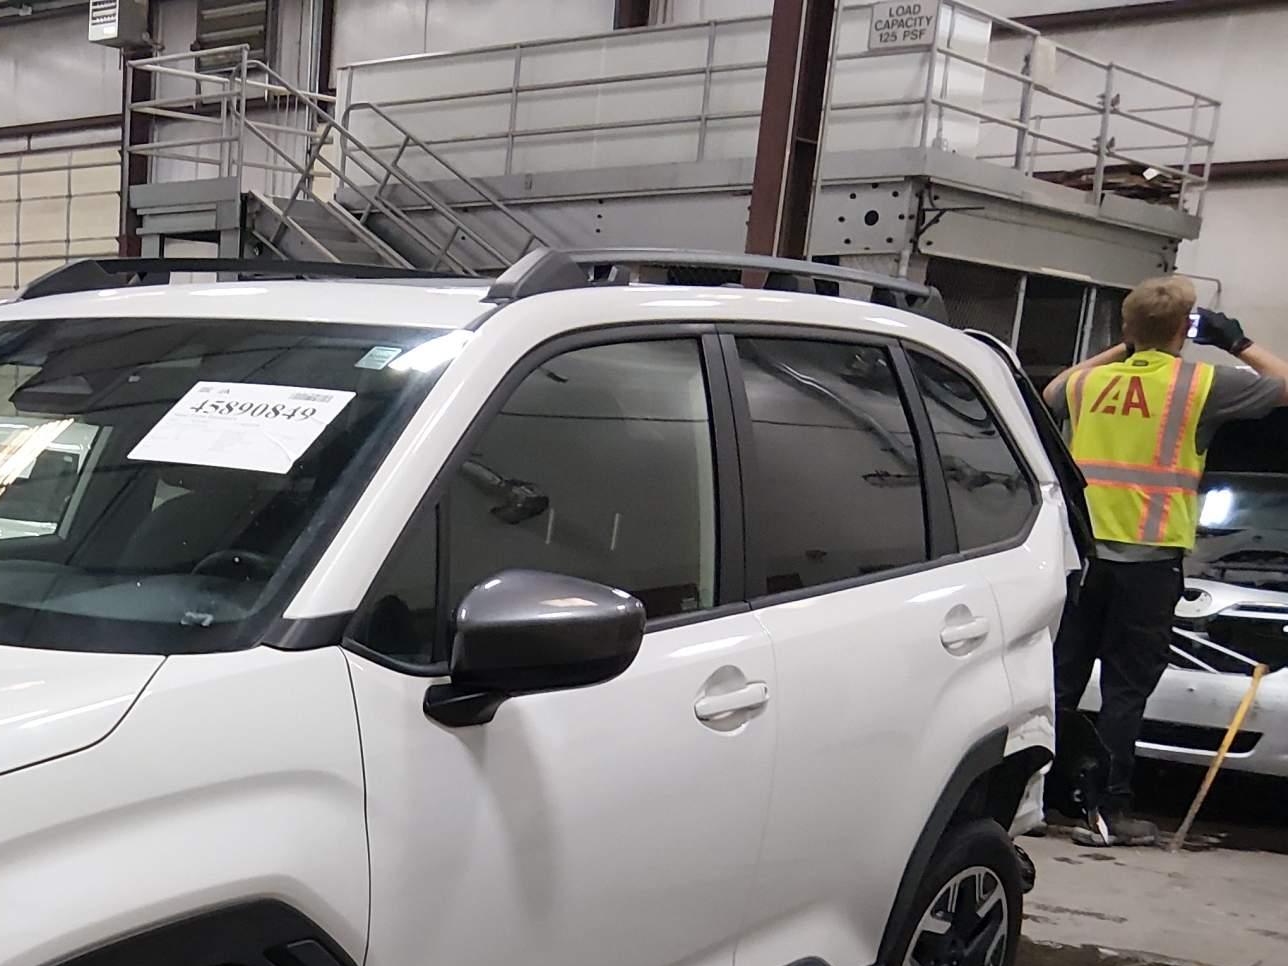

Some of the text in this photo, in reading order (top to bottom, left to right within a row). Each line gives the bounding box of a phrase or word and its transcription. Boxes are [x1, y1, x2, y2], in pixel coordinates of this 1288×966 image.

[888, 4, 921, 18] LOAD
[874, 16, 933, 31] CAPACITY
[879, 28, 927, 43] 125 PSF
[190, 400, 317, 421] 45890849
